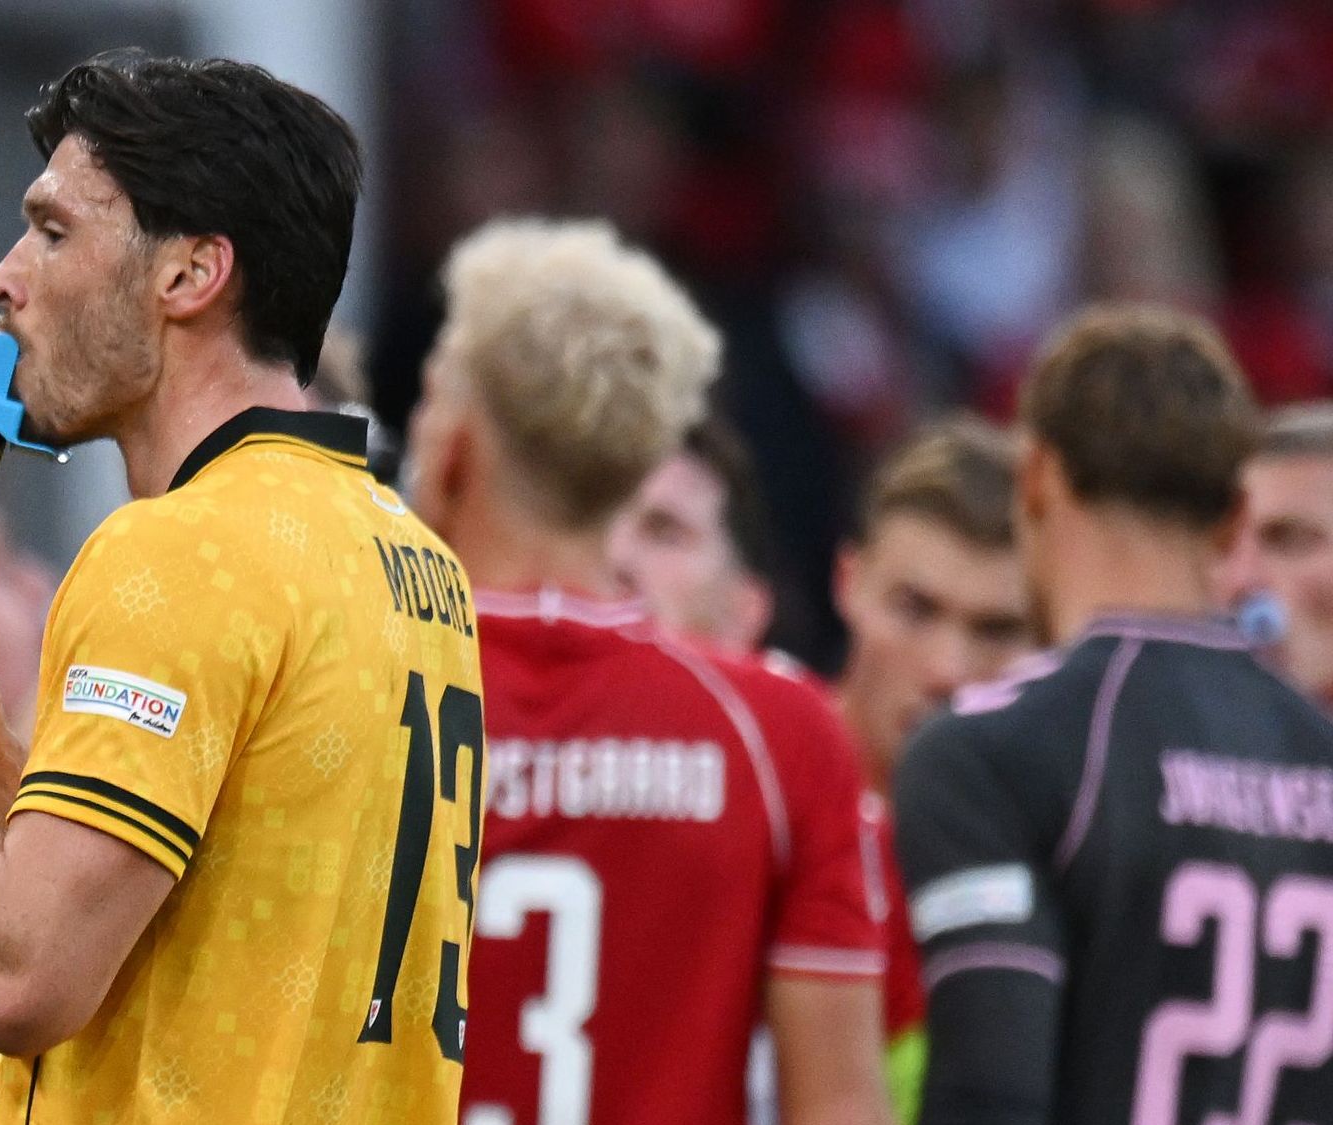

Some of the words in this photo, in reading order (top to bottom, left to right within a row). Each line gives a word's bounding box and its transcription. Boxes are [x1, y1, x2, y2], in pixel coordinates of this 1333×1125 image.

[373, 536, 474, 638] MOORE
[65, 680, 179, 722] FOUNDATION
[68, 668, 88, 679] UEFA
[357, 670, 482, 1067] 13
